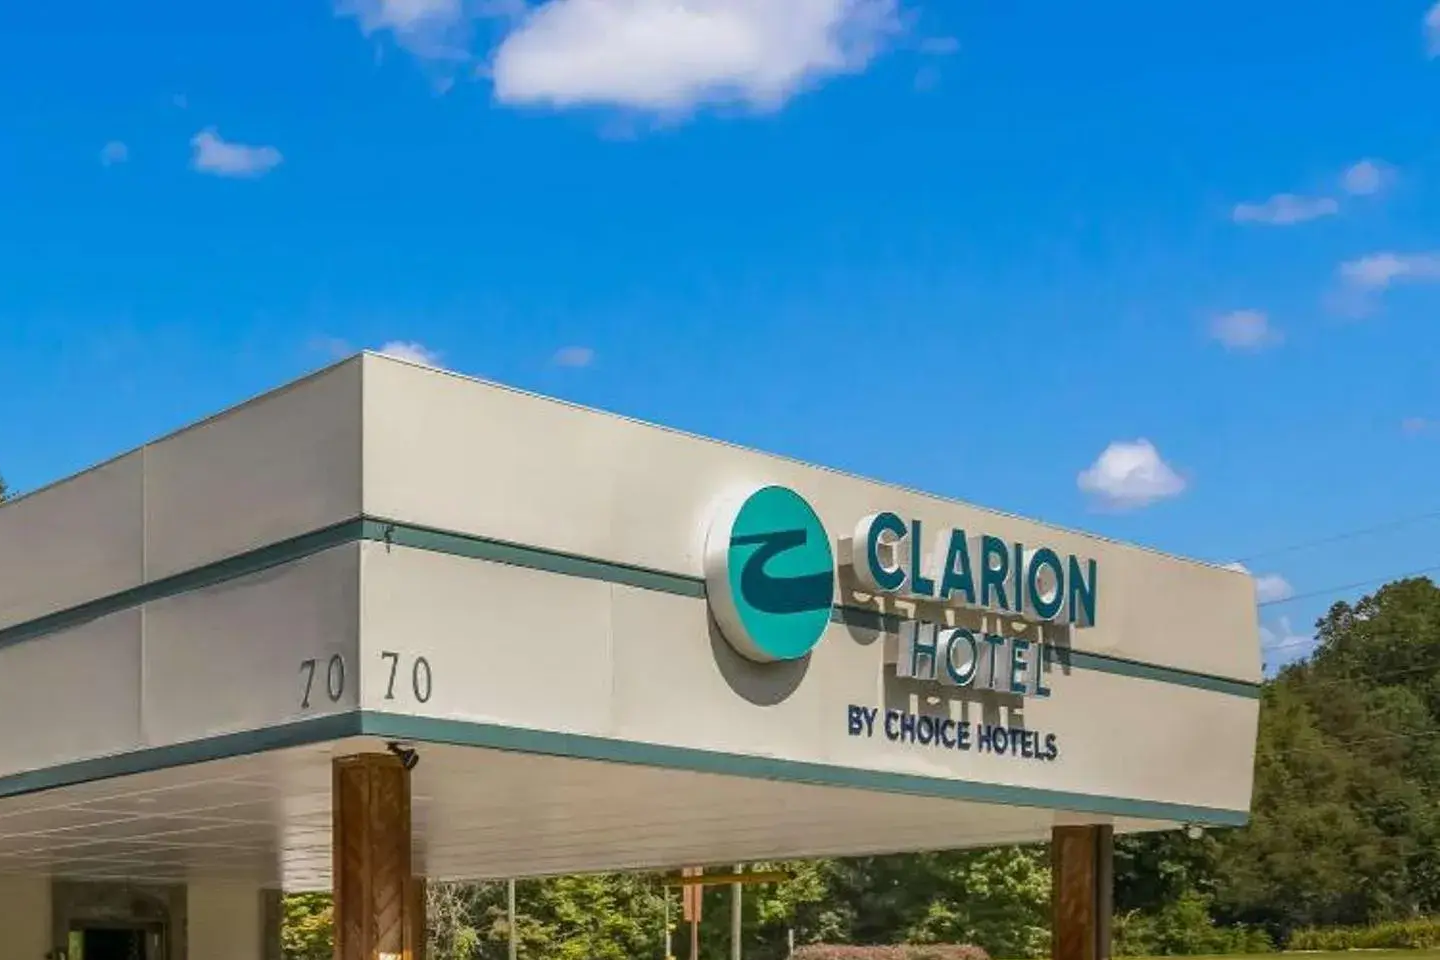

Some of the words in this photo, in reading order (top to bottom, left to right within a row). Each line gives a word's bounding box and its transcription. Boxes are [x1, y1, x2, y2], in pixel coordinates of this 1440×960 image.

[864, 511, 1097, 628] CLARION
[299, 652, 345, 709] 70
[380, 650, 432, 704] 70
[910, 620, 1052, 699] HOTEL
[847, 703, 879, 738] BY
[884, 710, 972, 751] CHOICE
[977, 722, 1060, 762] HOTELS
